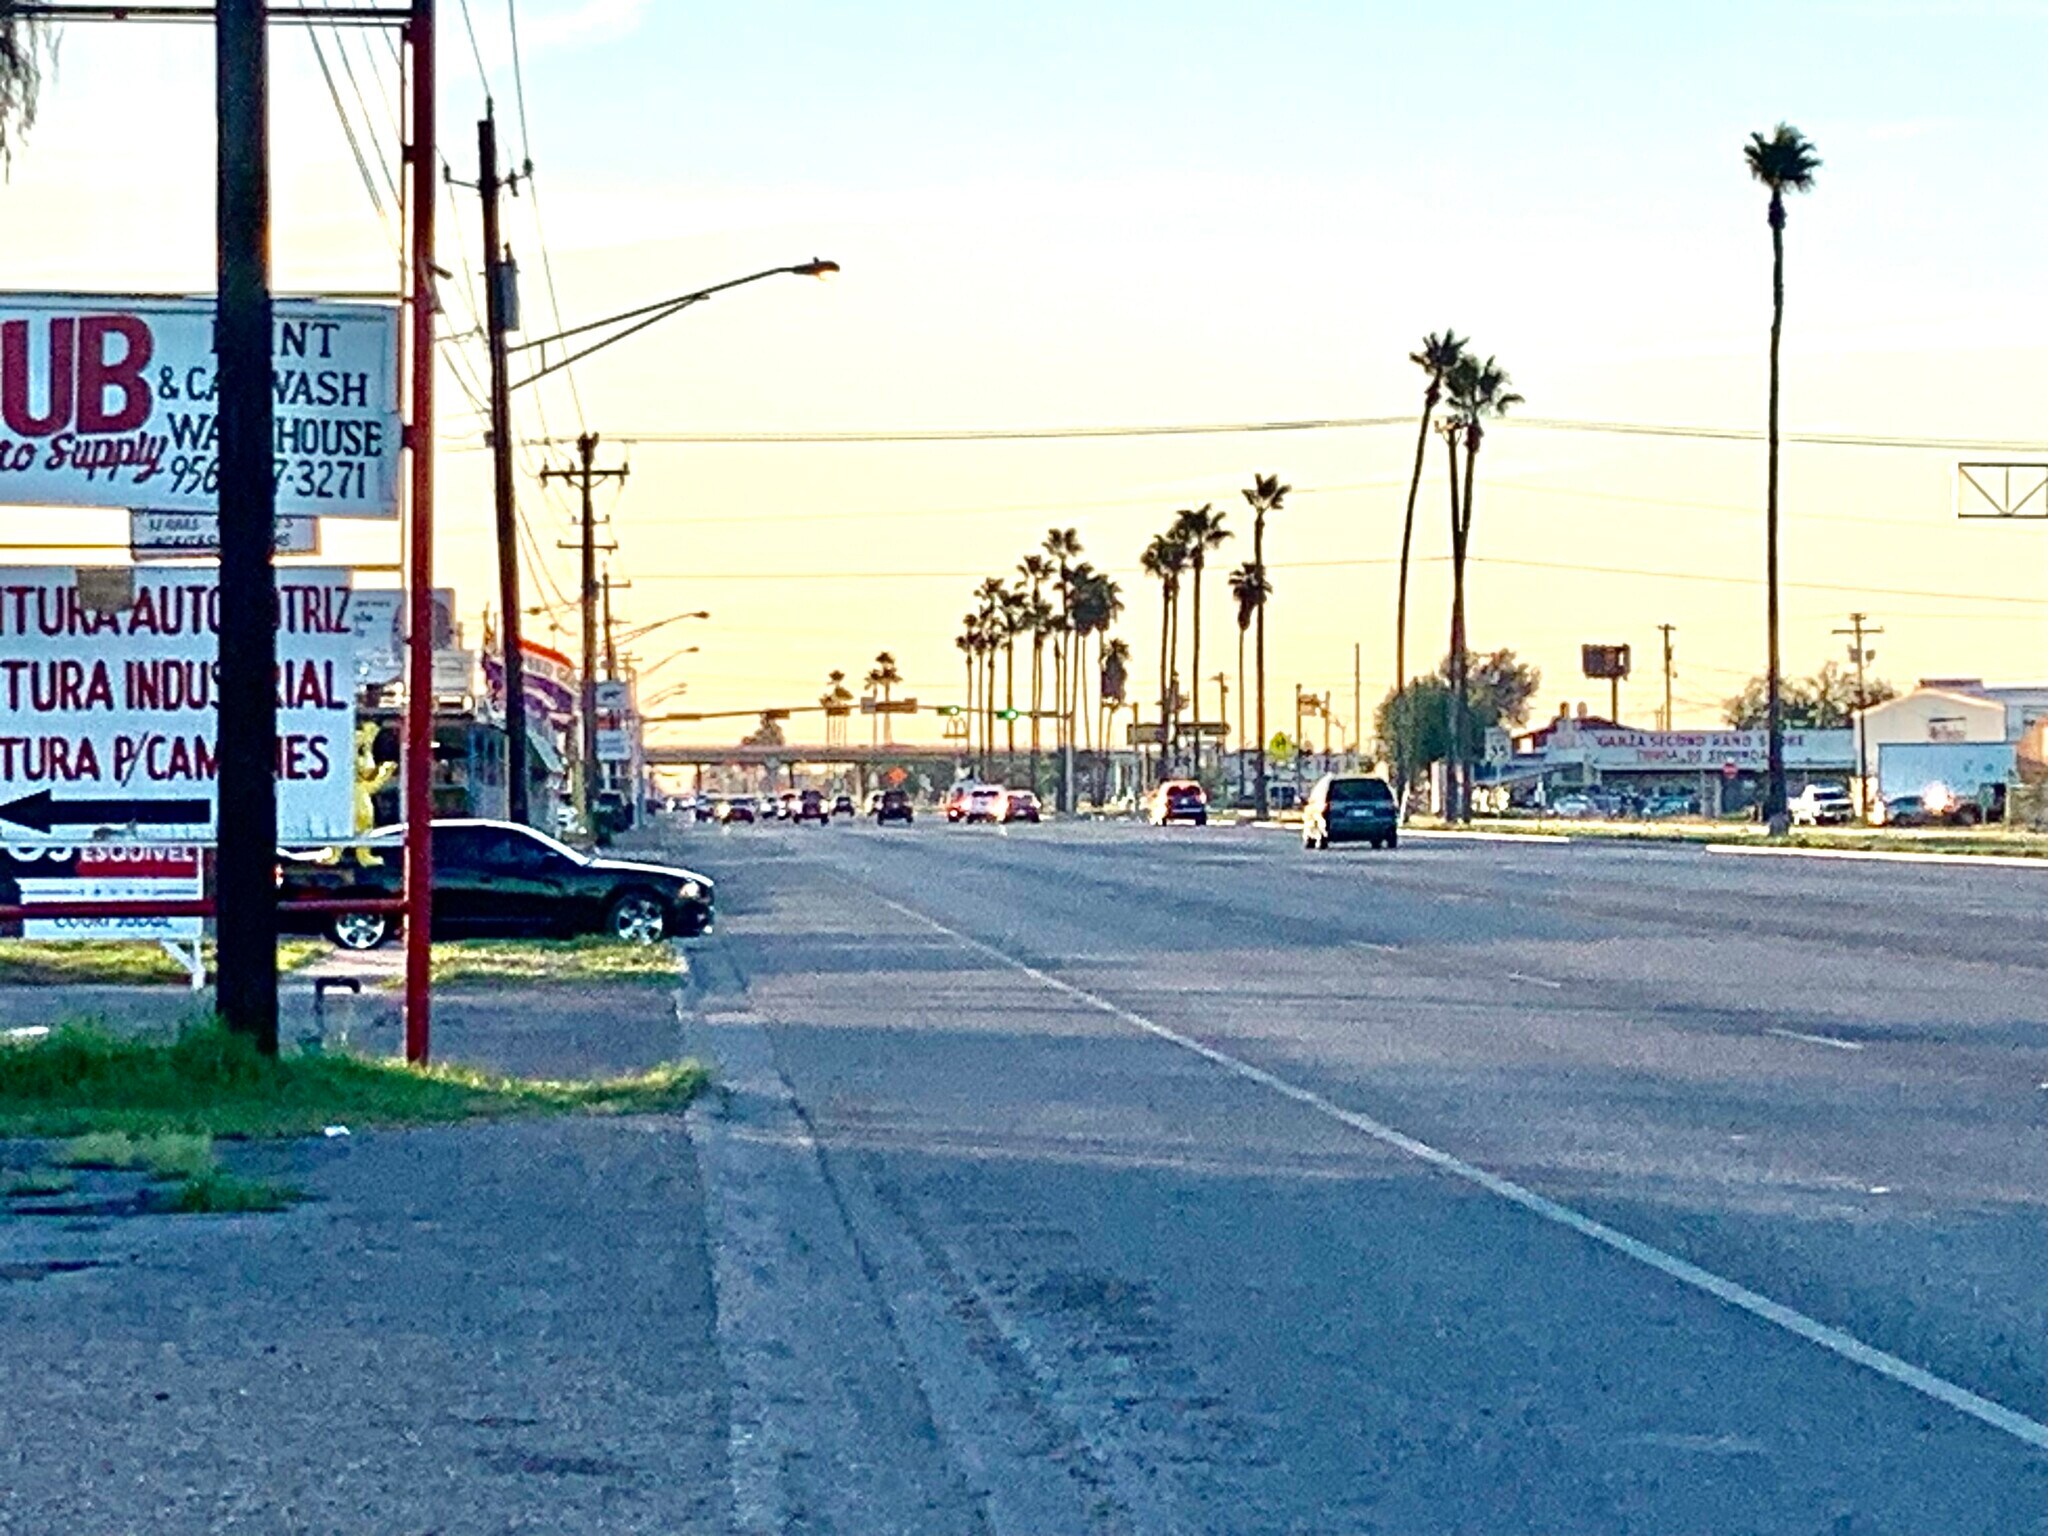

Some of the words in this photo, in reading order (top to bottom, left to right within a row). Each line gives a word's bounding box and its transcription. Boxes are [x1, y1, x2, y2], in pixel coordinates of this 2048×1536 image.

[1, 314, 154, 438] UB
[158, 366, 180, 399] &
[45, 431, 168, 483] Supply
[167, 413, 382, 457] WAHOUSE
